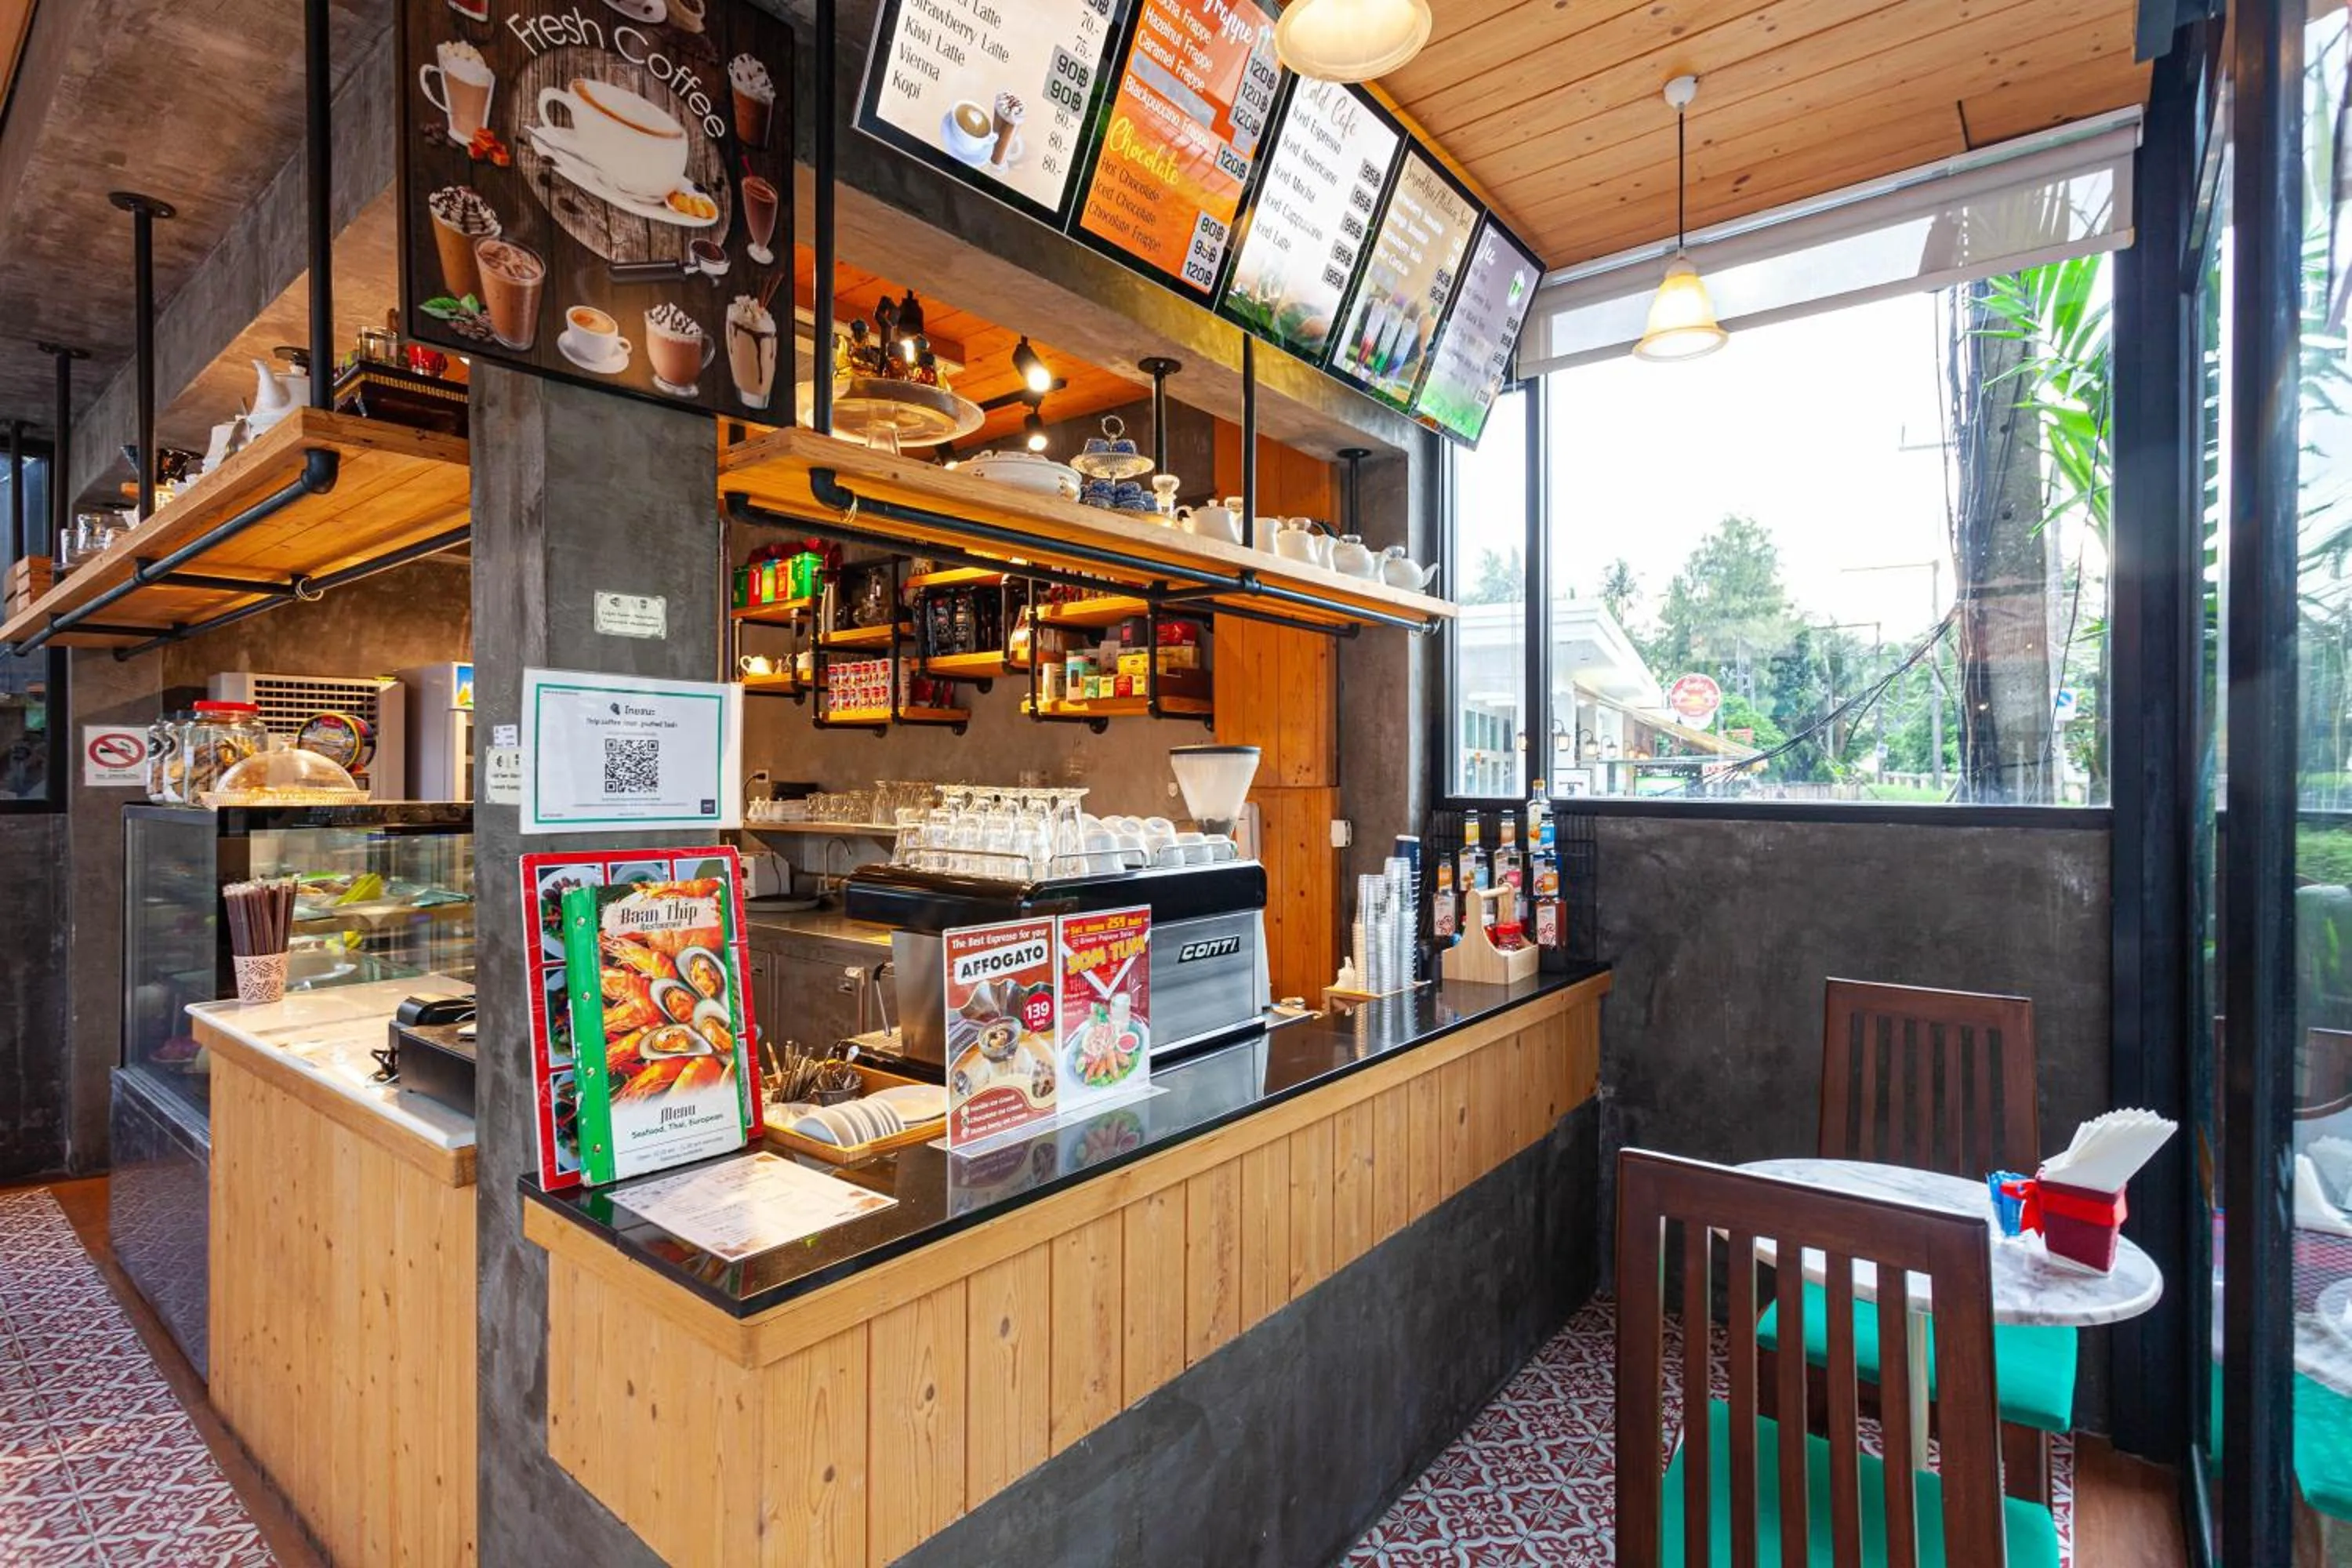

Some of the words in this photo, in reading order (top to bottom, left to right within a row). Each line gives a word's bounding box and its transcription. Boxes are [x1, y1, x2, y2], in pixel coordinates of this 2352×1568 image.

[905, 15, 932, 45] Kiwi
[935, 34, 966, 67] Latte
[1145, 4, 1183, 48] Hazelnut
[899, 42, 941, 81] Vienna
[981, 32, 1010, 63] Latte
[1138, 29, 1175, 69] Caramel
[506, 7, 604, 56] Fresh
[614, 26, 725, 138] Coffee
[892, 69, 922, 100] Kopi
[1100, 157, 1116, 174] Hot
[1109, 117, 1180, 185] Chocolate
[1094, 178, 1114, 201] Iced
[620, 908, 659, 925] Baan
[666, 901, 698, 926] Thip
[953, 938, 966, 949] The
[968, 935, 985, 948] Best
[1109, 934, 1146, 962] TUM
[961, 945, 1044, 979] AFFOGATO
[1025, 1001, 1050, 1020] 139
[661, 1105, 696, 1123] Menu
[689, 1113, 724, 1127] European
